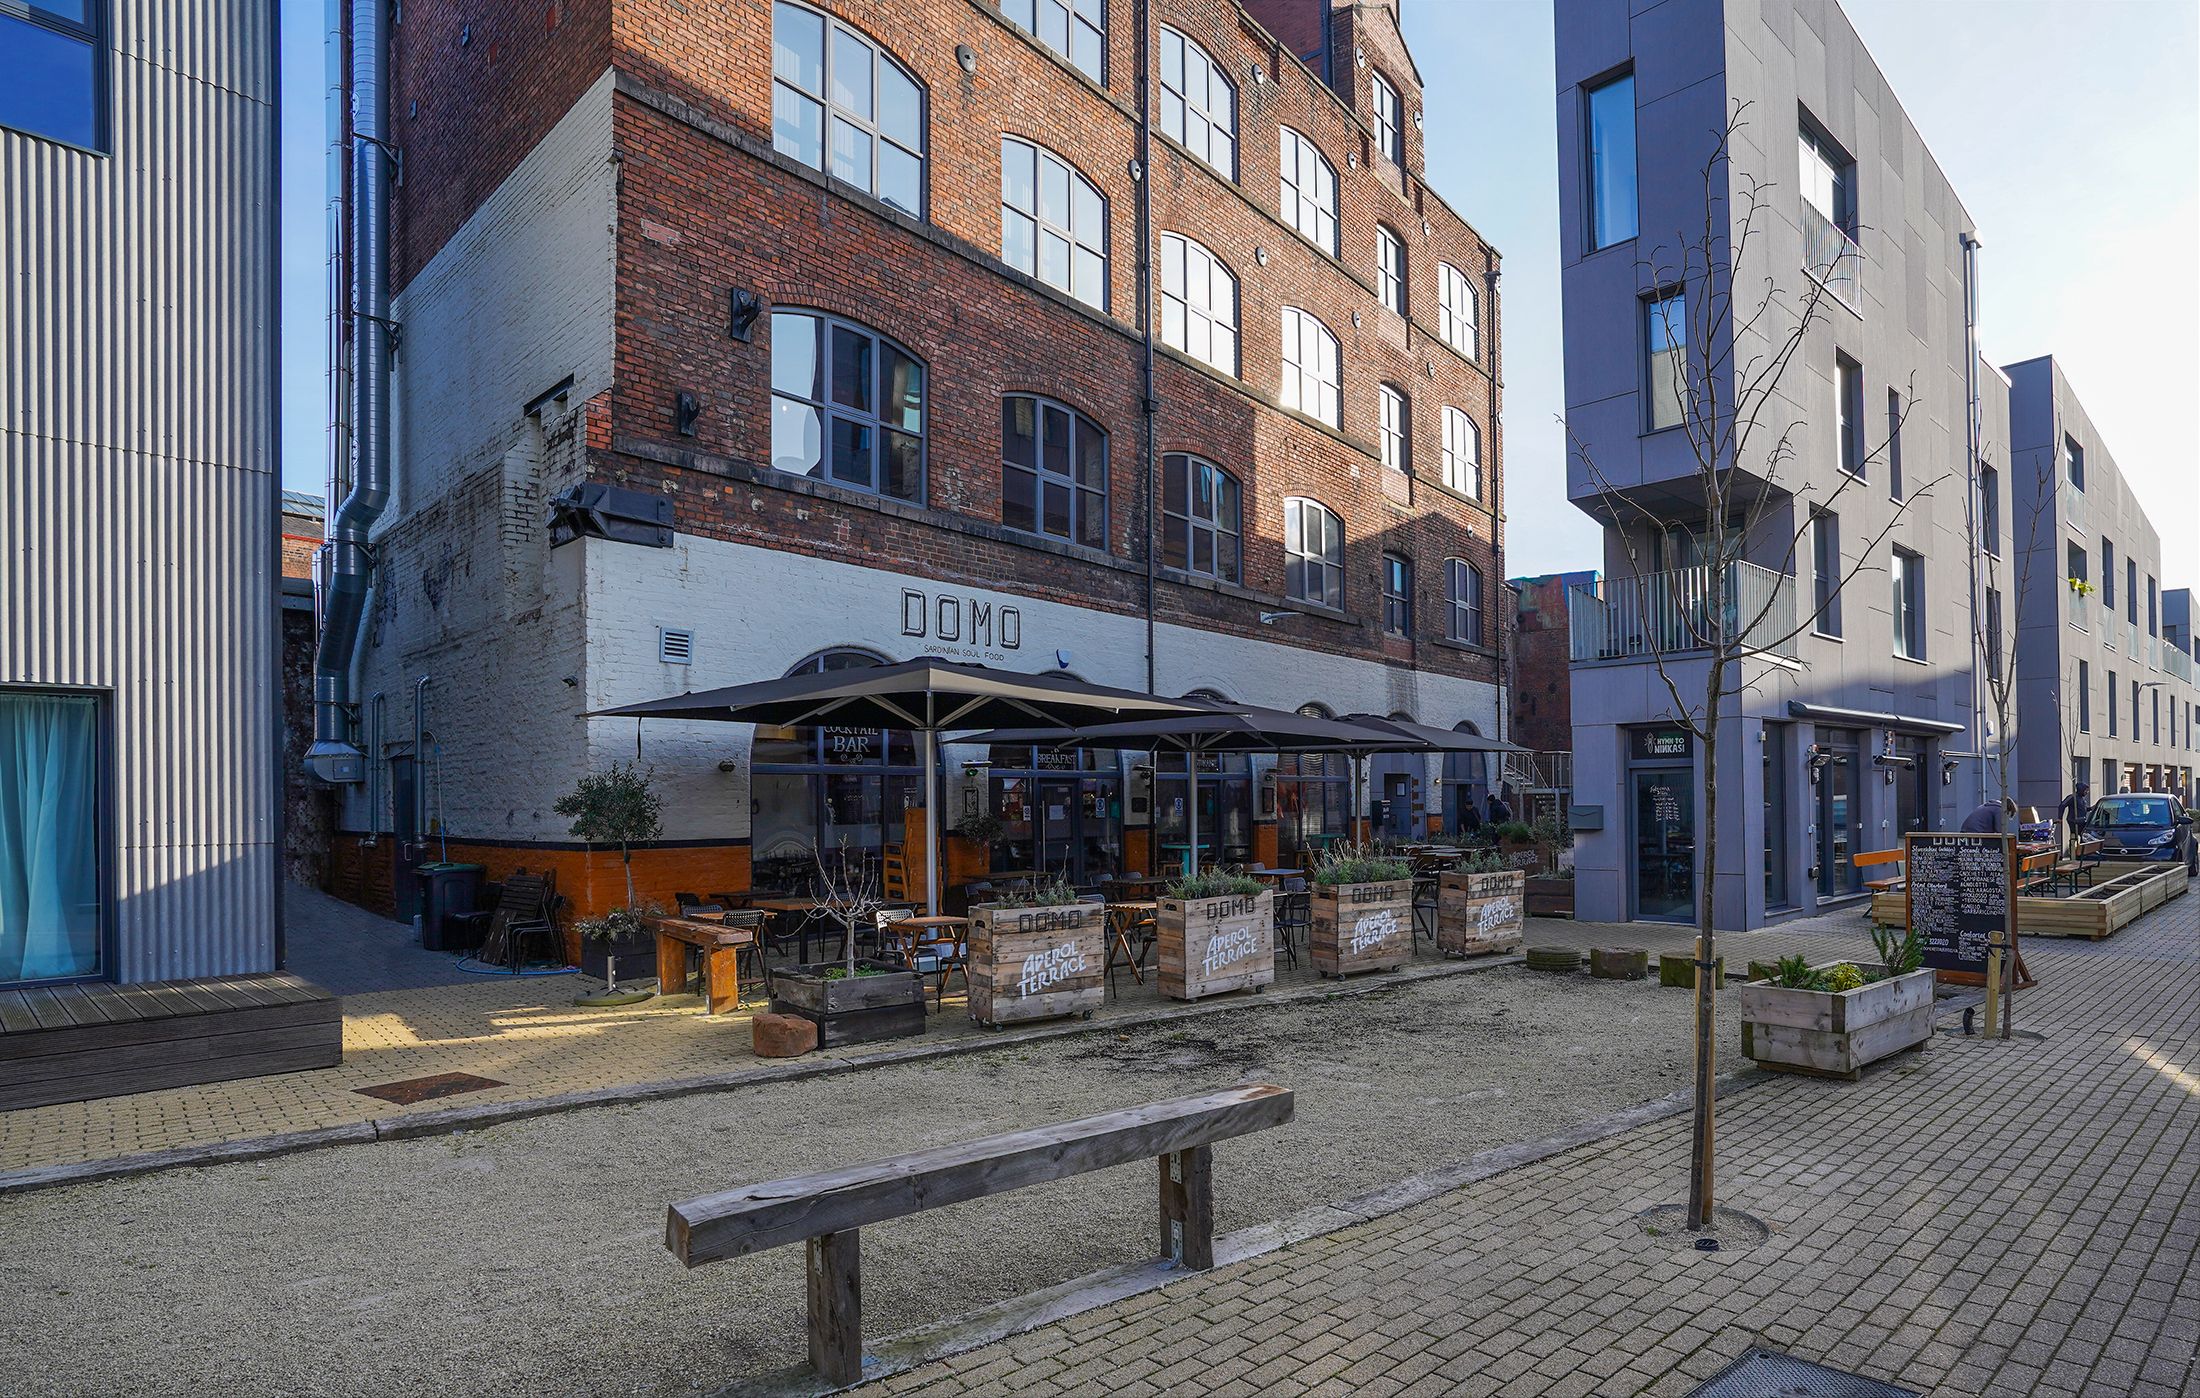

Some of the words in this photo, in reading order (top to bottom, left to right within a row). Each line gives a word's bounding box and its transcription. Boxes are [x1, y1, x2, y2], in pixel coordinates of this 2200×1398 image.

[901, 587, 1020, 650] DOMO
[924, 645, 960, 656] SARDINIAN
[962, 649, 980, 658] SOUL
[984, 651, 1005, 661] FOOD
[833, 735, 871, 753] BAR
[1654, 745, 1685, 753] NINKASI
[1352, 884, 1394, 904] DOMO
[1481, 874, 1514, 891] DOMO
[1019, 909, 1082, 933] DOMO
[1206, 896, 1256, 921] DOMO
[1477, 904, 1515, 937] TERRACE
[1481, 895, 1510, 922] APEROL
[1350, 919, 1398, 955] TERRACE
[1354, 909, 1391, 939] APEROL
[1206, 926, 1252, 959] APEROL
[1022, 940, 1079, 980] APEROL
[1201, 937, 1258, 977] TERRACE
[1016, 953, 1087, 1001] TERRACE
